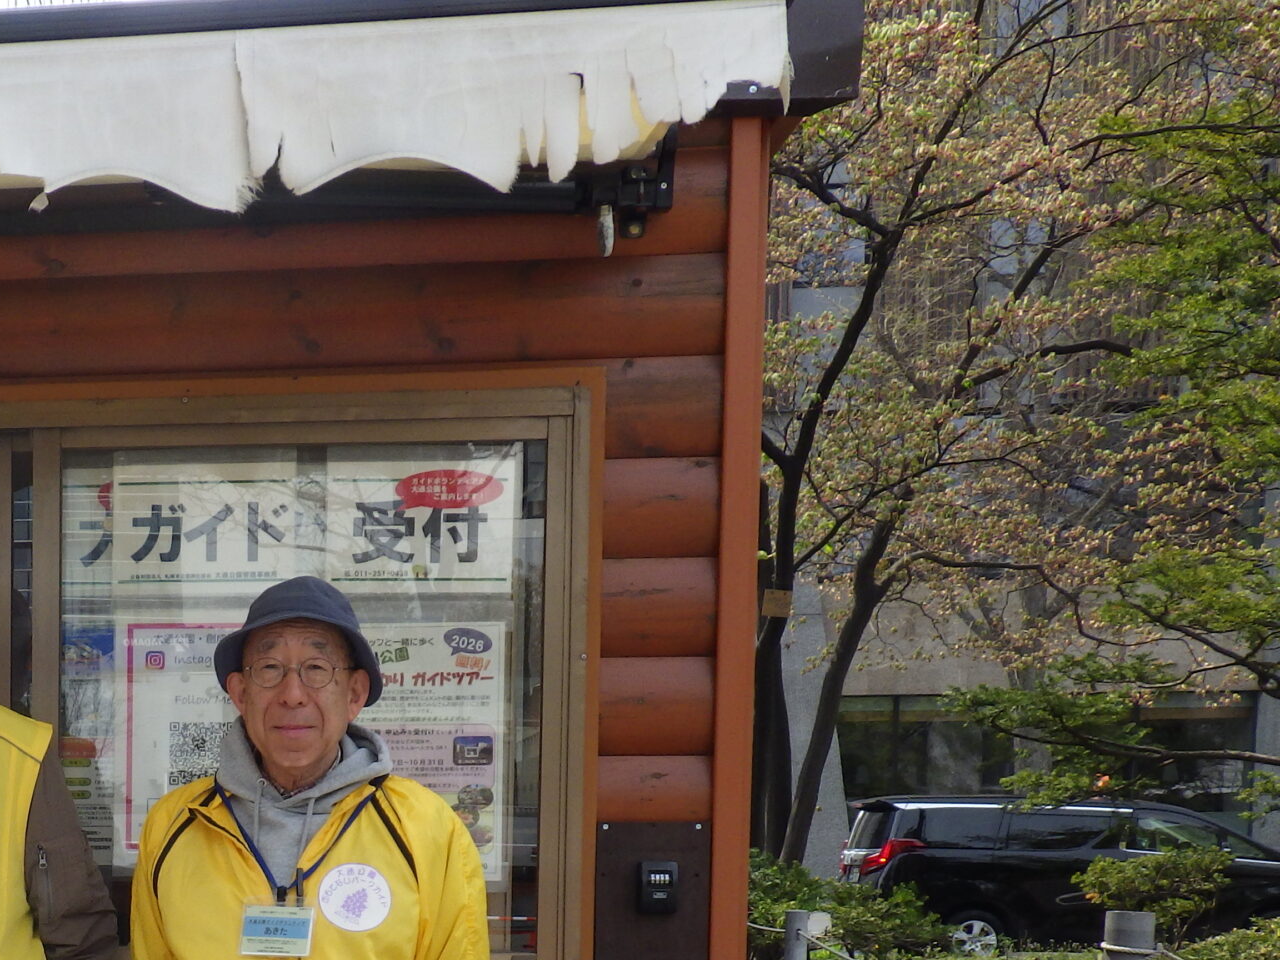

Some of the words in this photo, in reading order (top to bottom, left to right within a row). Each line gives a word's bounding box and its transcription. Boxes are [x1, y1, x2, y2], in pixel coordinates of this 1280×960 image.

[130, 501, 288, 563] ガイド
[352, 500, 488, 563] 受付
[451, 634, 484, 651] 2026
[411, 671, 494, 687] ガイドツアー
